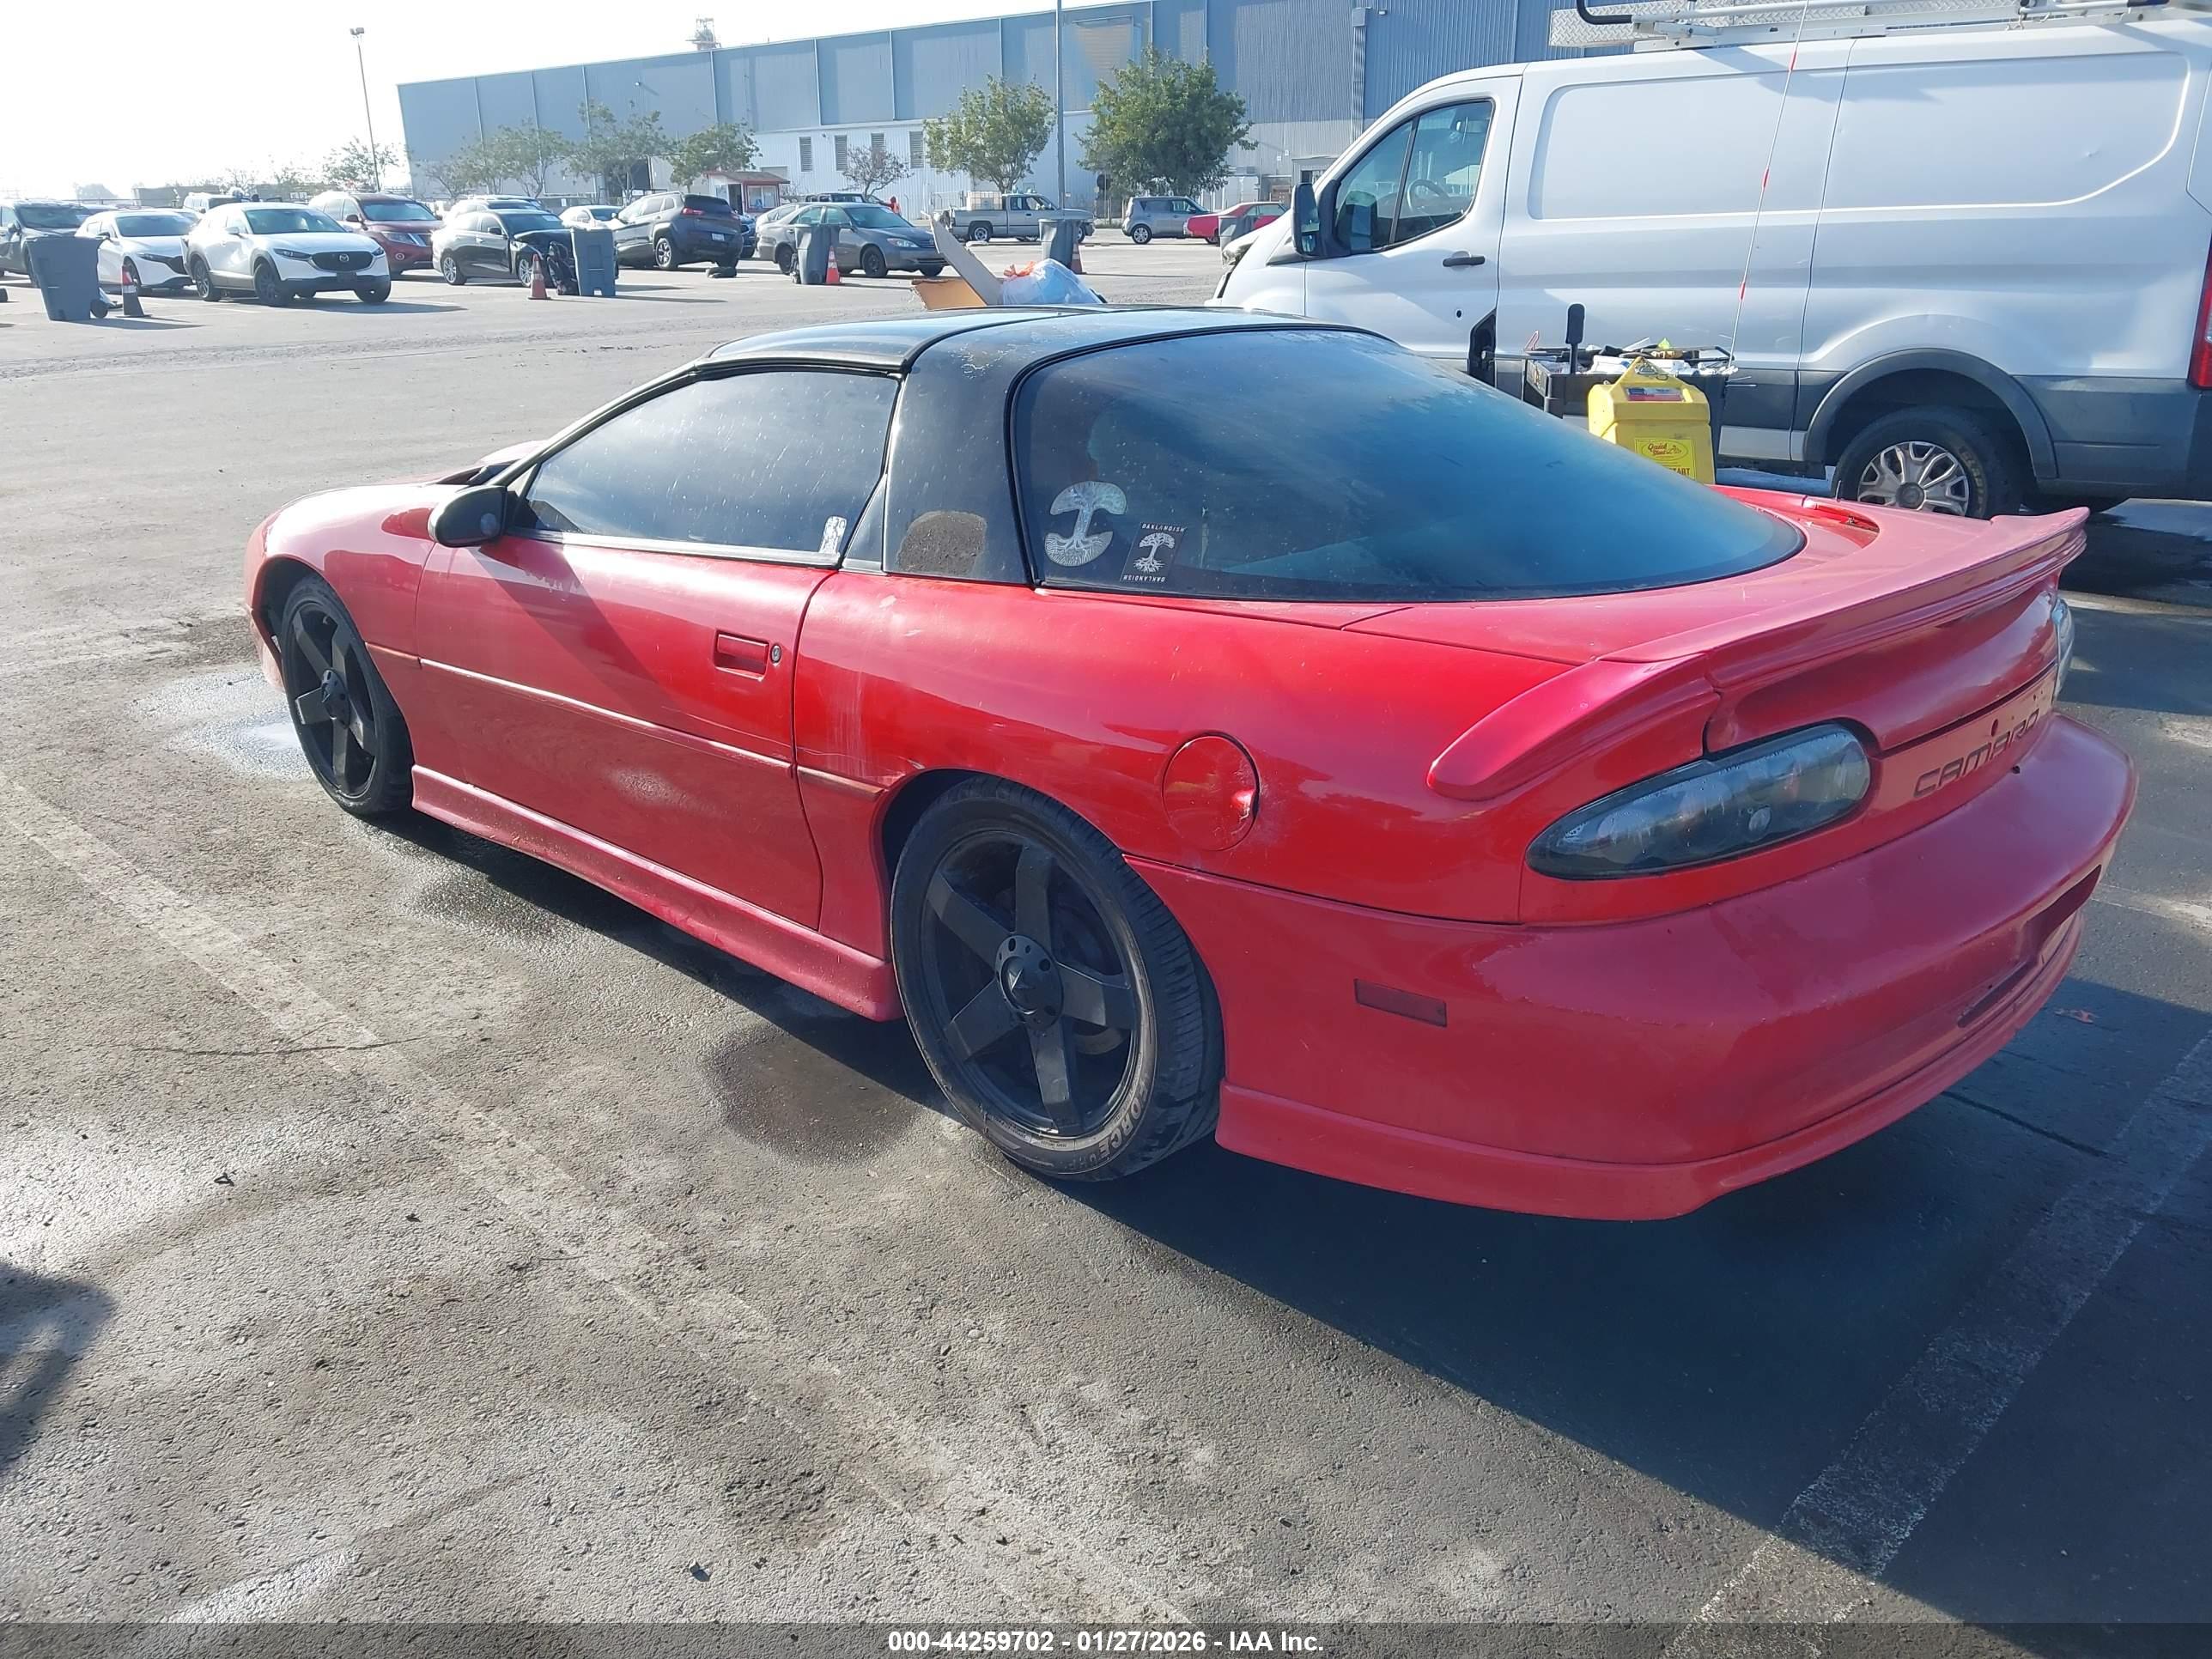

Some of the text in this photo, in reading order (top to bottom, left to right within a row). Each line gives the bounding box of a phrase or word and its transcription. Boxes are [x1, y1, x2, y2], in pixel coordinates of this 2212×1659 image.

[1141, 523, 1185, 532] OAKLANDISH
[1122, 574, 1166, 582] OAKLANDISH
[1913, 708, 2039, 798] CAMARO
